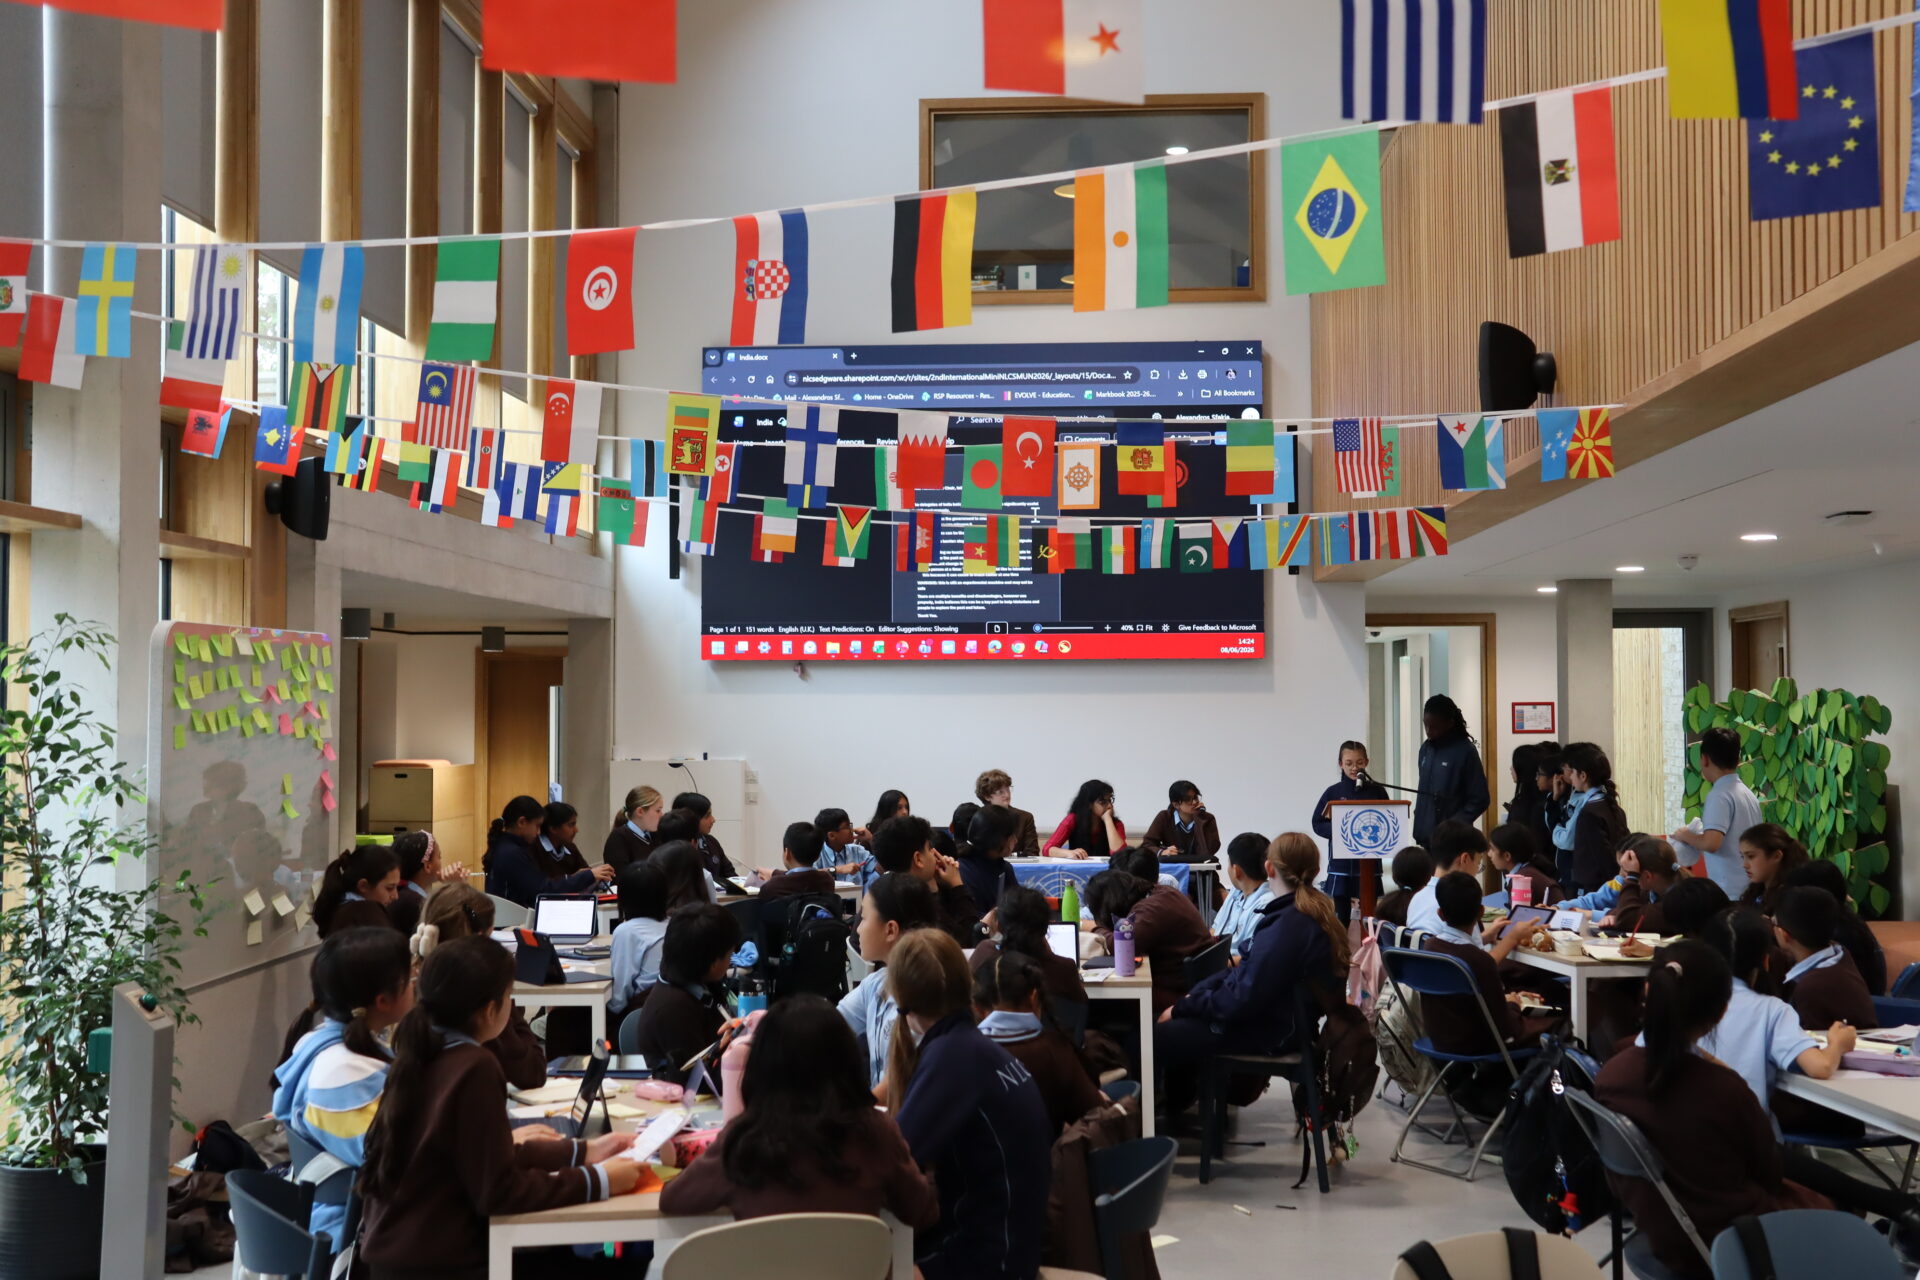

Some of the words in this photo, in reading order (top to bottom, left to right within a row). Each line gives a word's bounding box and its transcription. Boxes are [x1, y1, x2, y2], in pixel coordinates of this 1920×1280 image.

[739, 353, 768, 361] India.docx
[756, 418, 773, 426] India
[710, 626, 724, 634] Page
[934, 625, 959, 633] Showing
